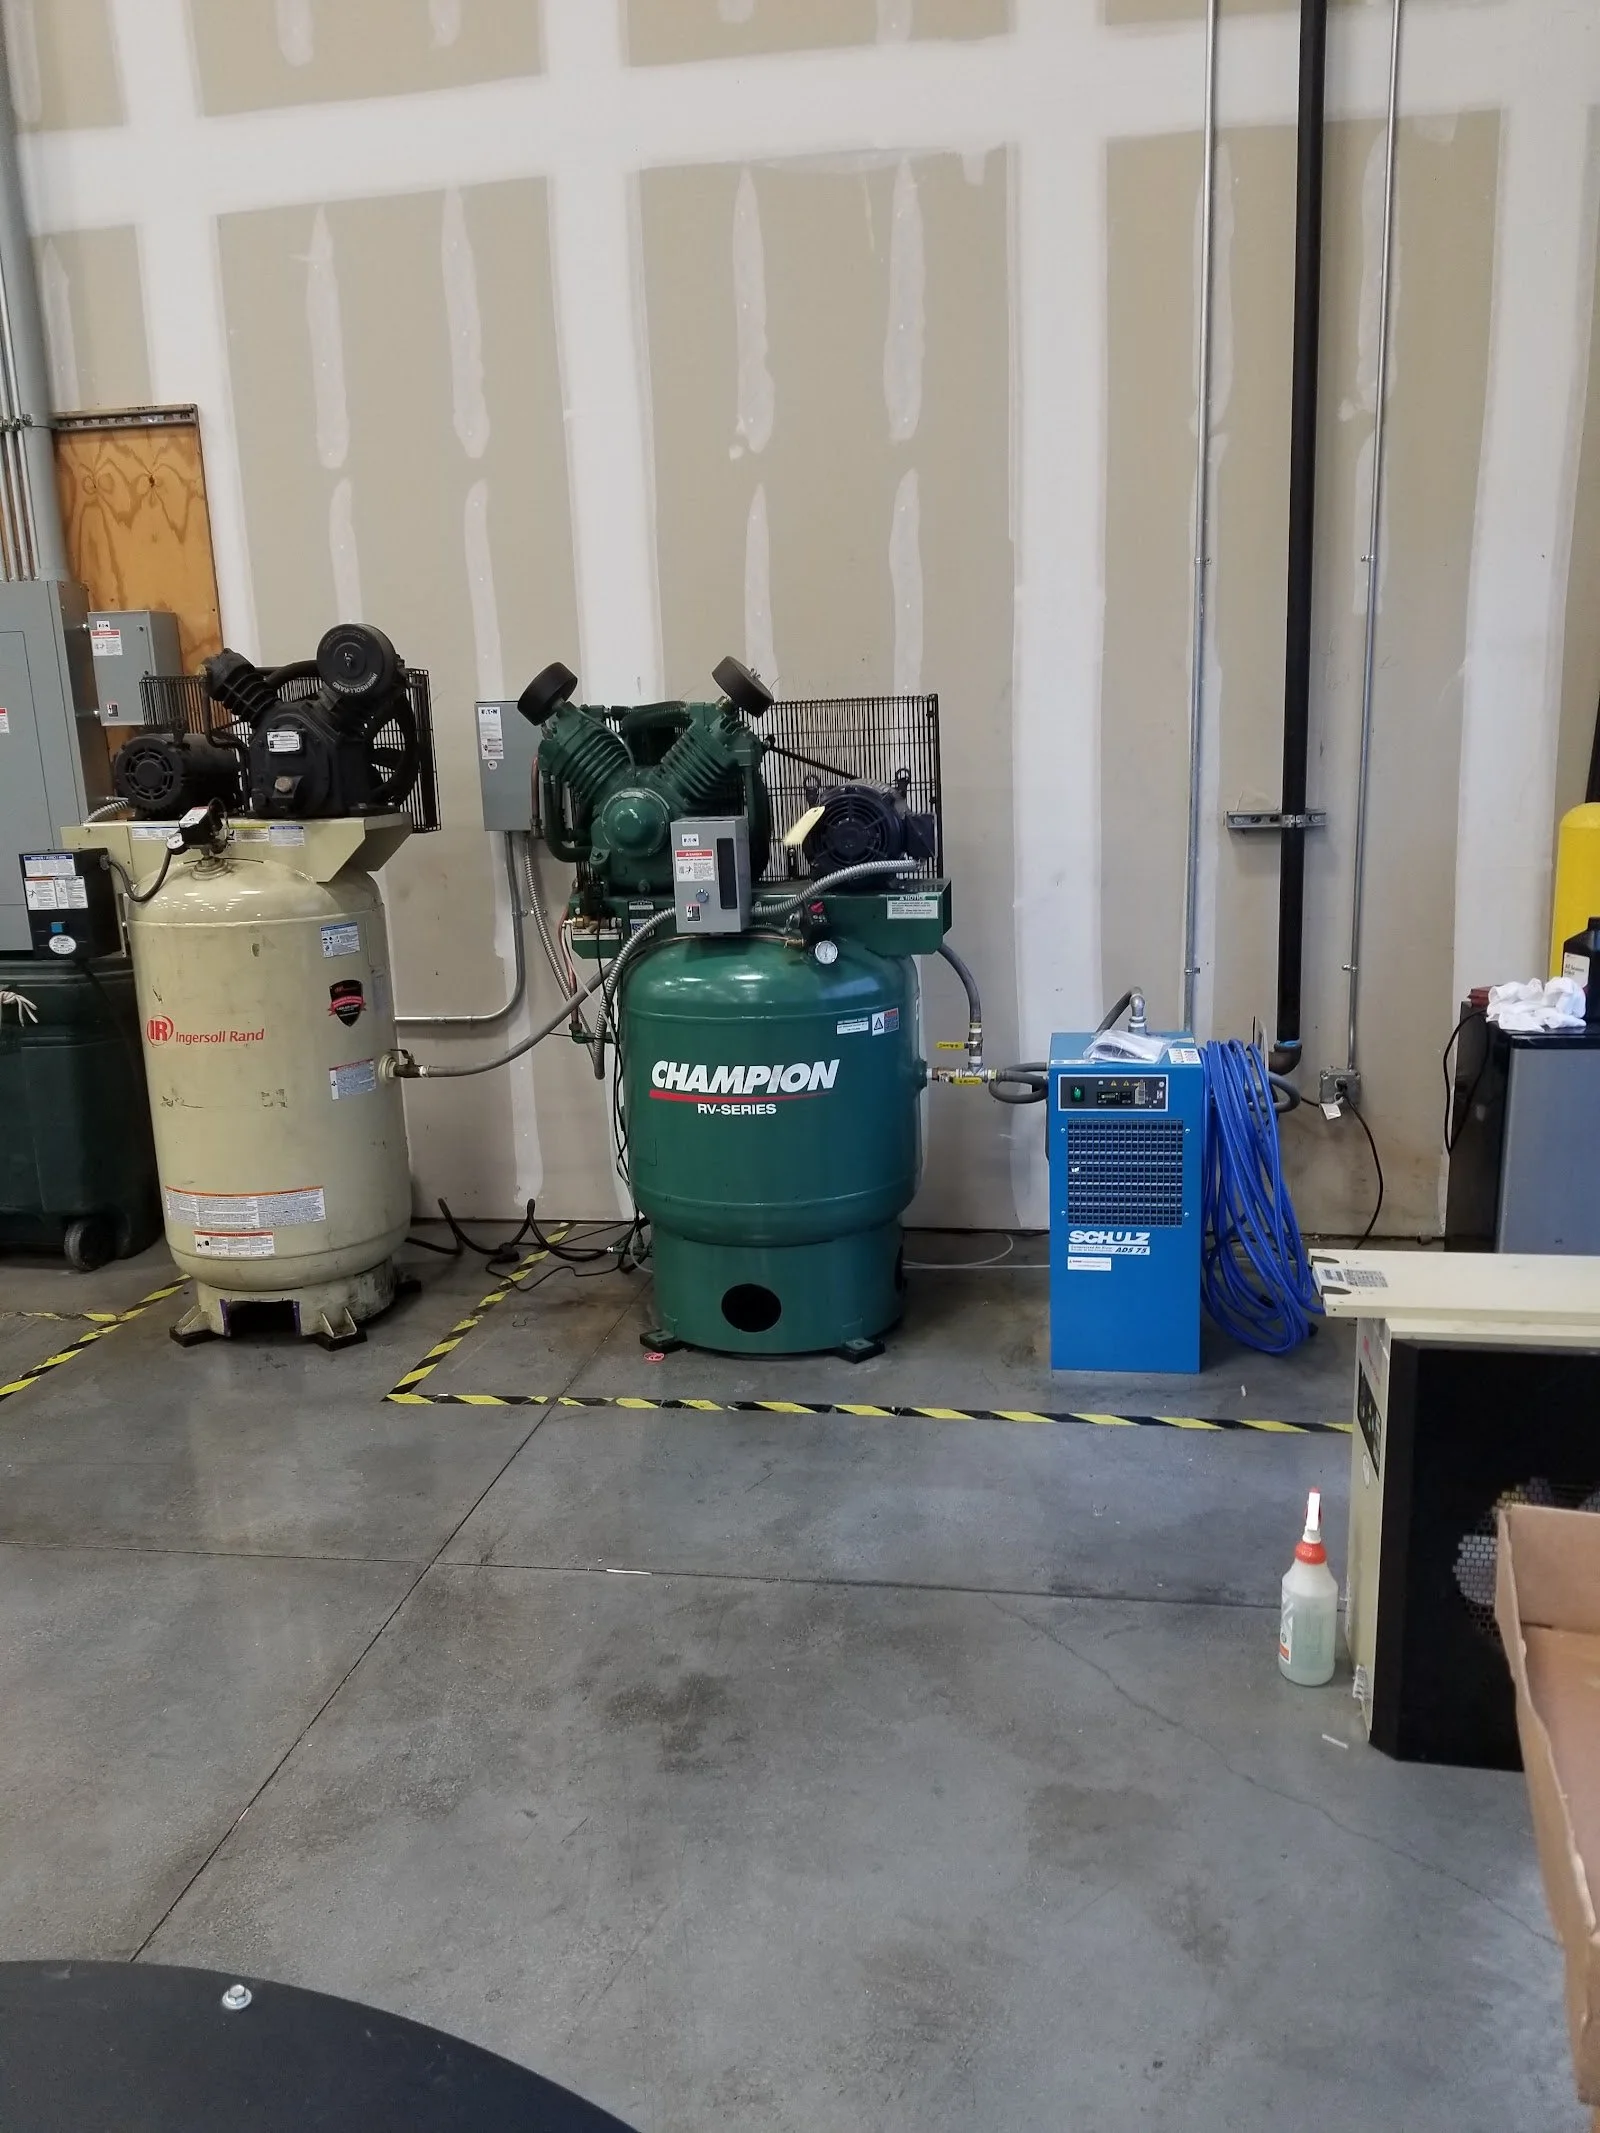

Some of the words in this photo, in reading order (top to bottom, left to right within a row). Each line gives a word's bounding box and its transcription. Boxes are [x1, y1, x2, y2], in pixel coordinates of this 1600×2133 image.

[149, 1020, 168, 1041] IR
[176, 1031, 226, 1045] Ingersoll
[230, 1028, 264, 1042] Rand
[651, 1059, 840, 1094] CHAMPION
[697, 1104, 777, 1115] RV-SERIES
[1069, 1230, 1151, 1245] SCHULZ
